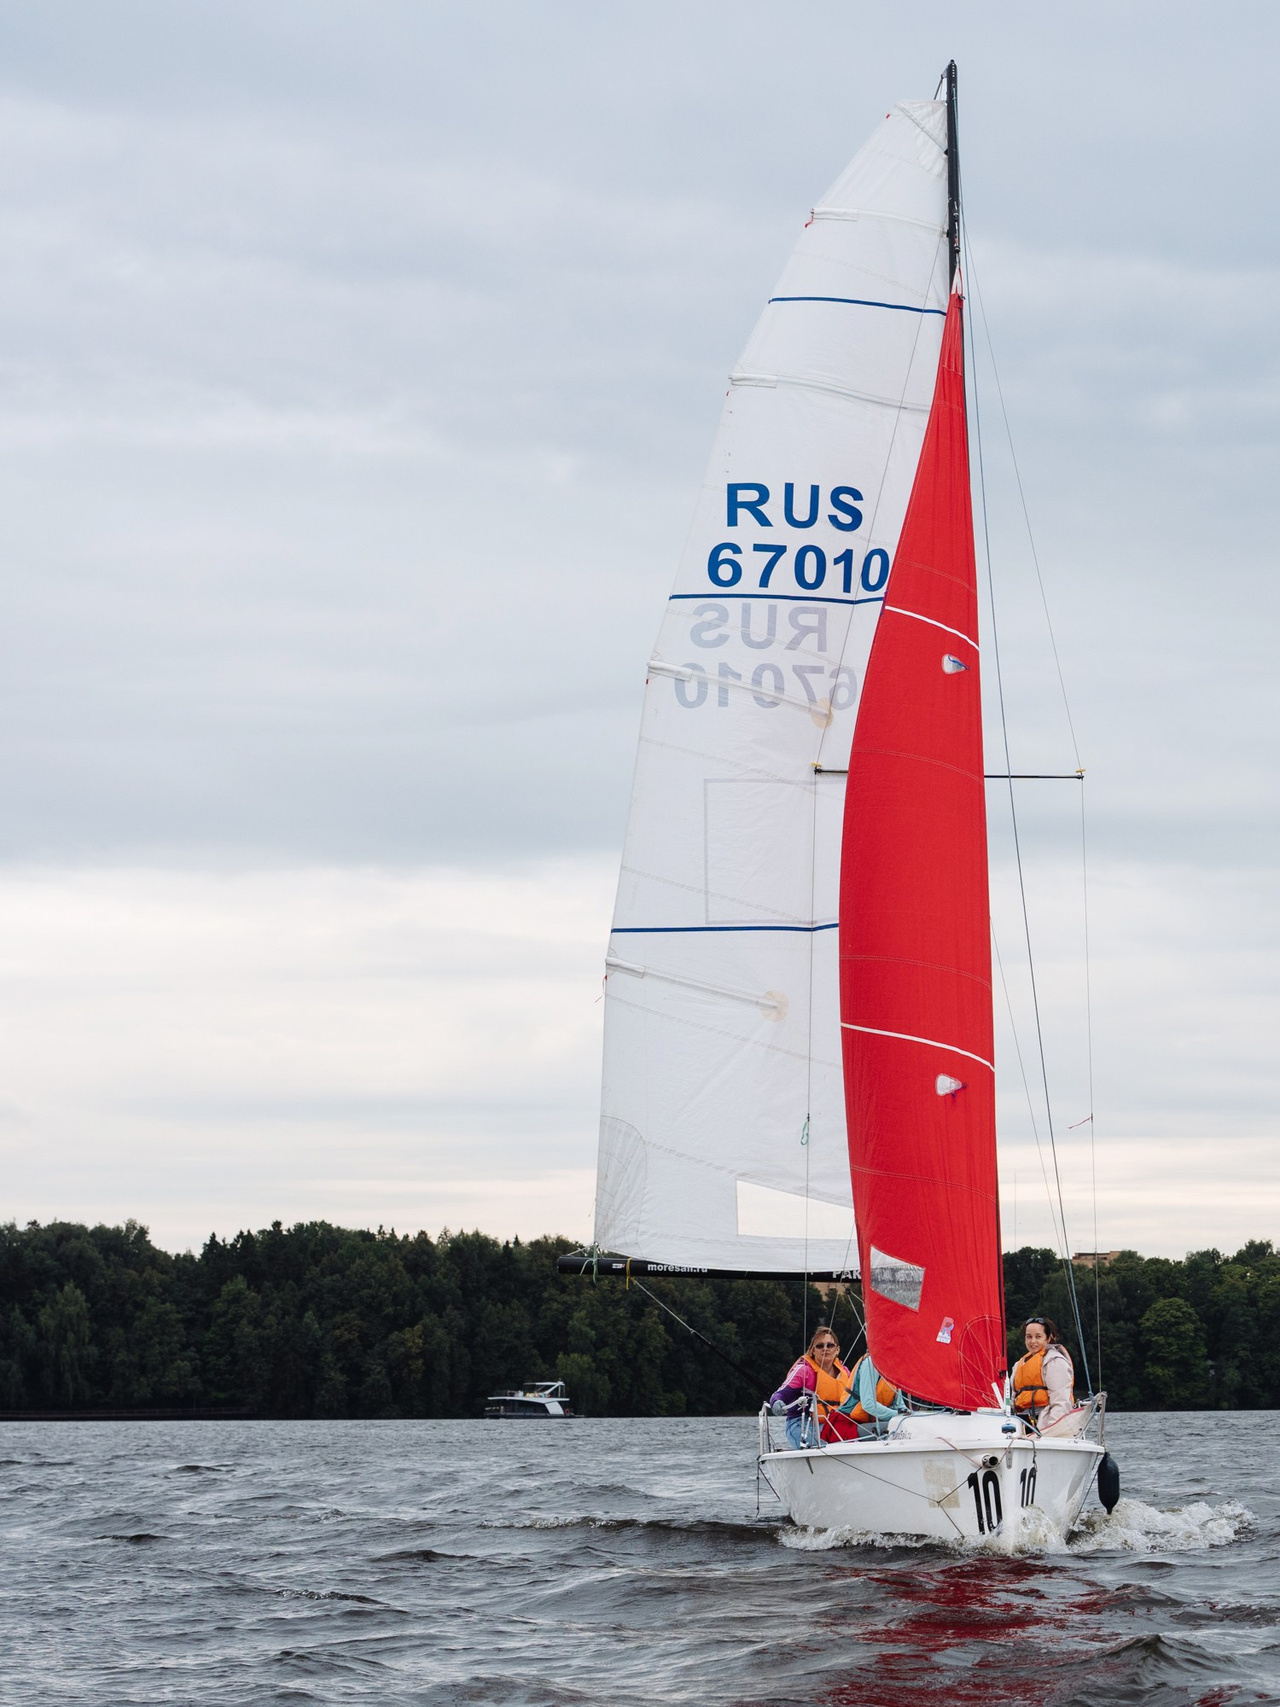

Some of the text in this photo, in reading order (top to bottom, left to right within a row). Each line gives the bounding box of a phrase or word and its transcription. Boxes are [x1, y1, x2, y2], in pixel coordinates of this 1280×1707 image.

[726, 482, 864, 532] RUS
[707, 542, 890, 593] 67010
[967, 1470, 1003, 1536] 10
[1020, 1467, 1037, 1508] 10
